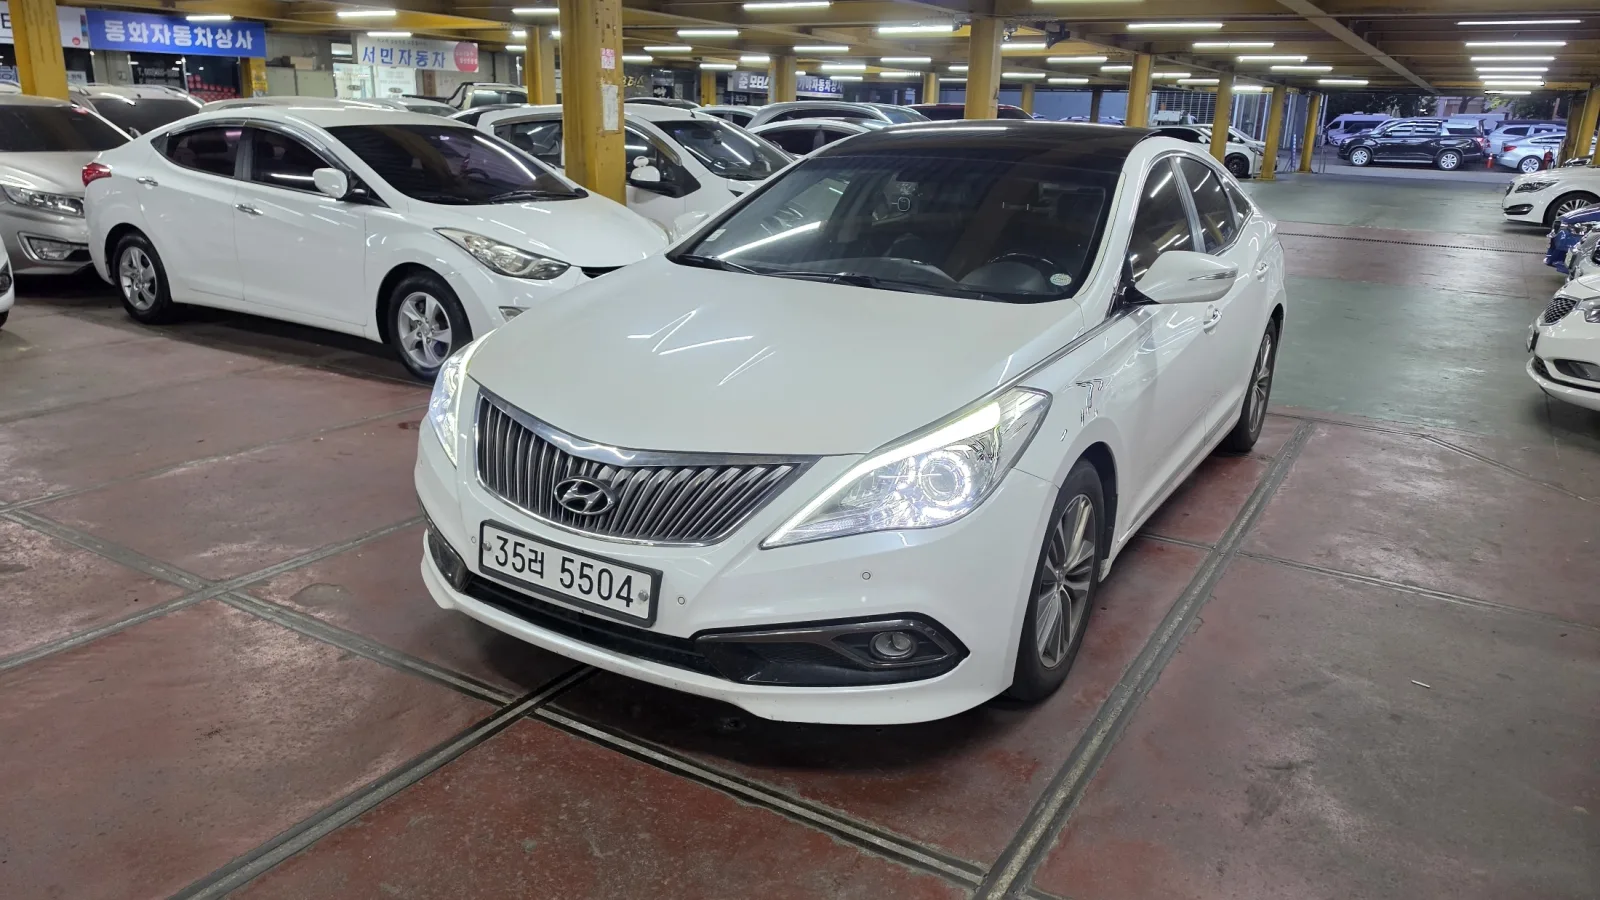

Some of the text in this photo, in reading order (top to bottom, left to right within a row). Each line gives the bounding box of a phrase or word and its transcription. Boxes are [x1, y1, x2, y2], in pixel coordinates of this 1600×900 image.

[104, 20, 253, 50] 동화자동차상사
[362, 46, 446, 69] 서민자동차
[494, 535, 634, 608] 35러 5504
